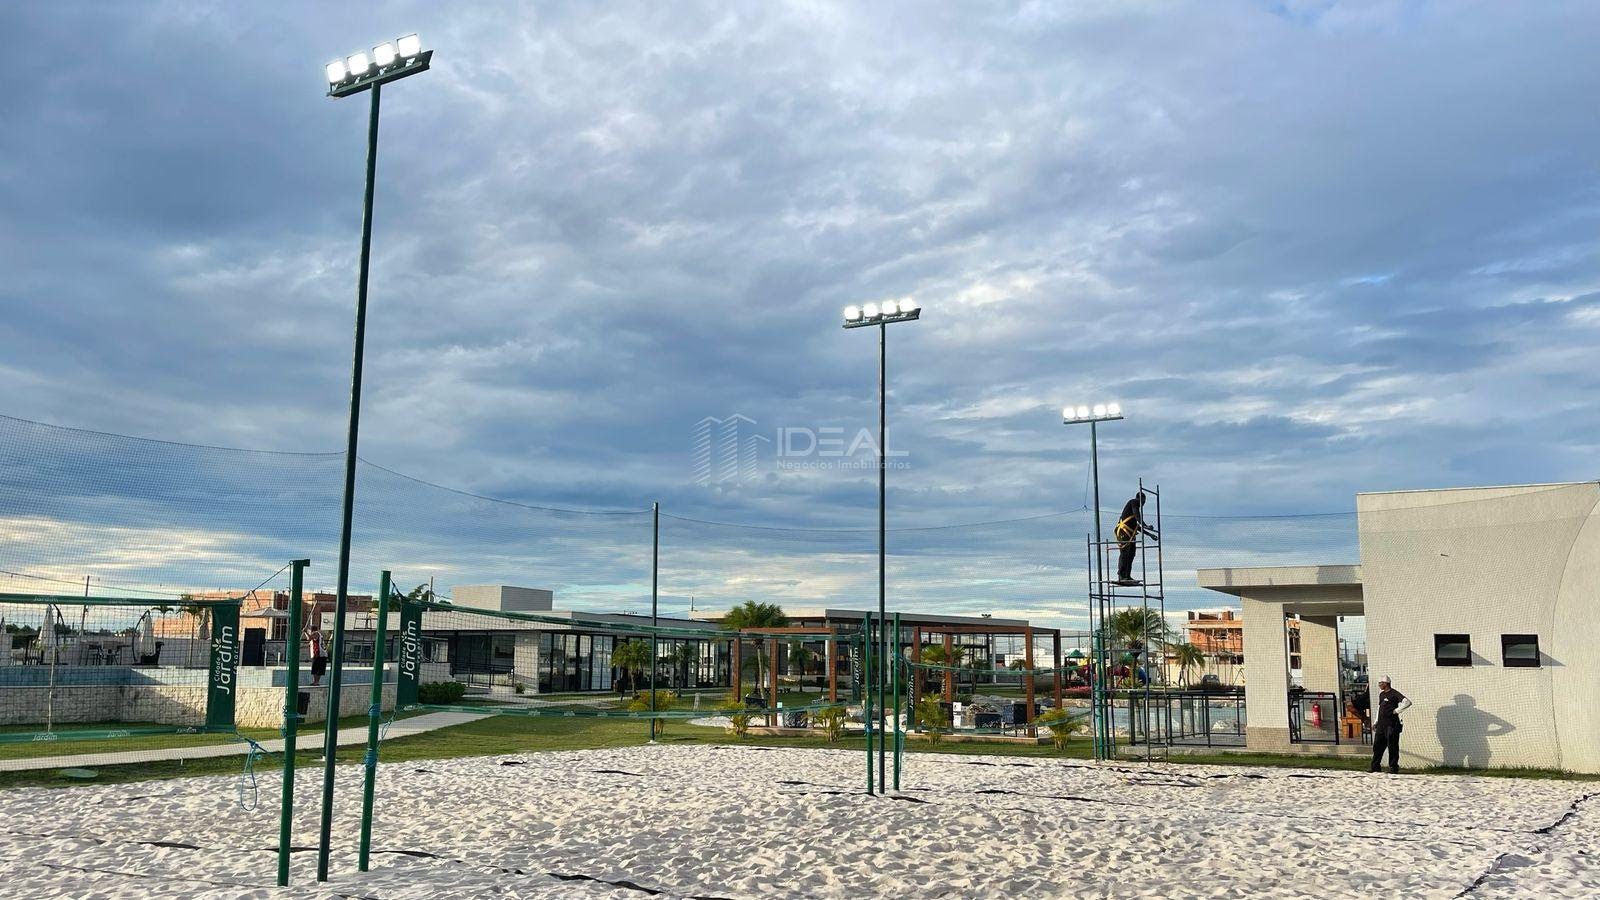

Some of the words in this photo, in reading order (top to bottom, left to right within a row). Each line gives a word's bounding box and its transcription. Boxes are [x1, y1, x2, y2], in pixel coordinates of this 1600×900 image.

[216, 625, 233, 695] Jardim
[403, 620, 416, 681] Jardim
[32, 732, 58, 742] Jardim
